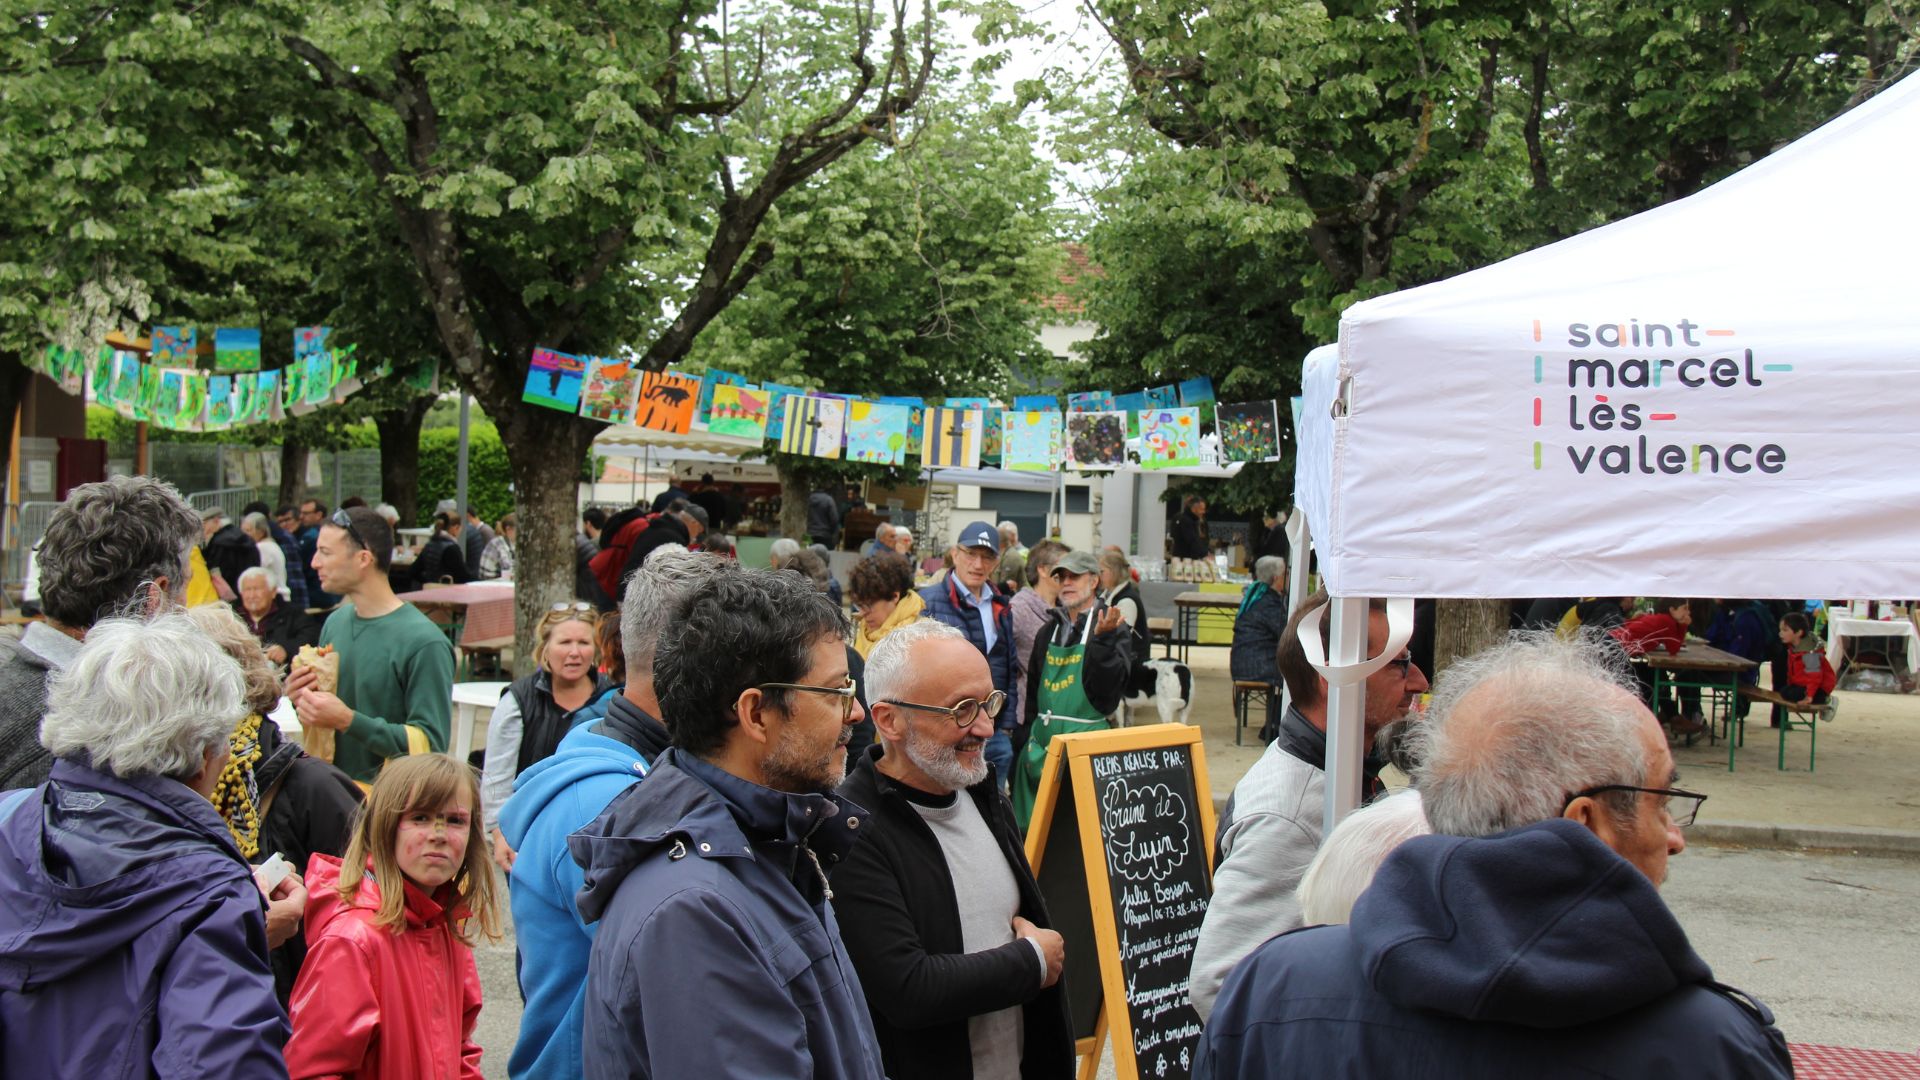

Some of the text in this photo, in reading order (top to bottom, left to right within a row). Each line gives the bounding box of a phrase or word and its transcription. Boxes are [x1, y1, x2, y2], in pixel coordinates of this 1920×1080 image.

[1566, 434, 1786, 474] valence
[1109, 786, 1174, 830] Graine de
[1113, 830, 1178, 870] Lupin
[1134, 1027, 1161, 1055] Guide
